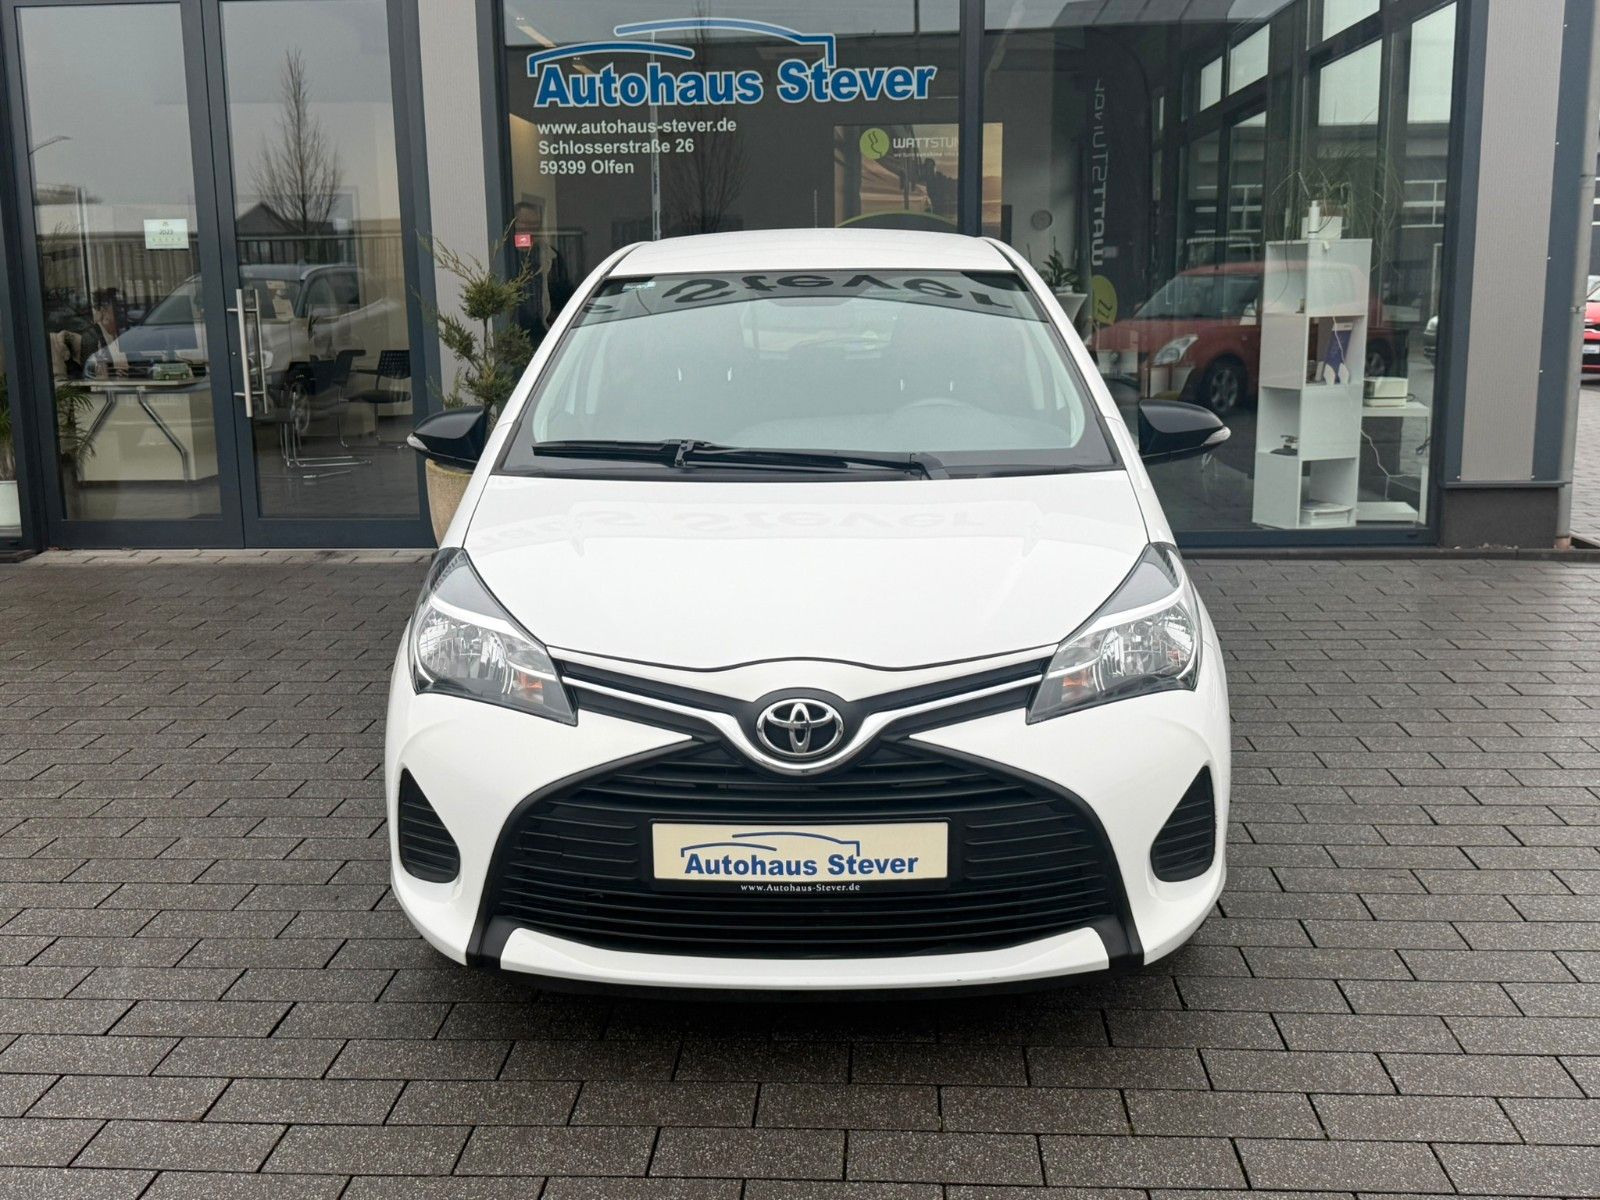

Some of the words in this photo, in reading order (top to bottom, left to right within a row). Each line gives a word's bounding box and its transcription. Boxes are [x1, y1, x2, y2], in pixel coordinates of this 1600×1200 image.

[534, 62, 763, 107] Autohaus
[777, 59, 936, 102] Stever
[537, 117, 737, 135] www.autohaus-stever.de
[538, 138, 671, 155] Schlosserstraße
[675, 138, 695, 153] 26
[540, 160, 586, 175] 59399
[591, 159, 635, 174] Olfen
[684, 853, 818, 876] Autohaus
[827, 853, 919, 875] Stever
[740, 882, 861, 892] www.Autohaus-Stever.de
